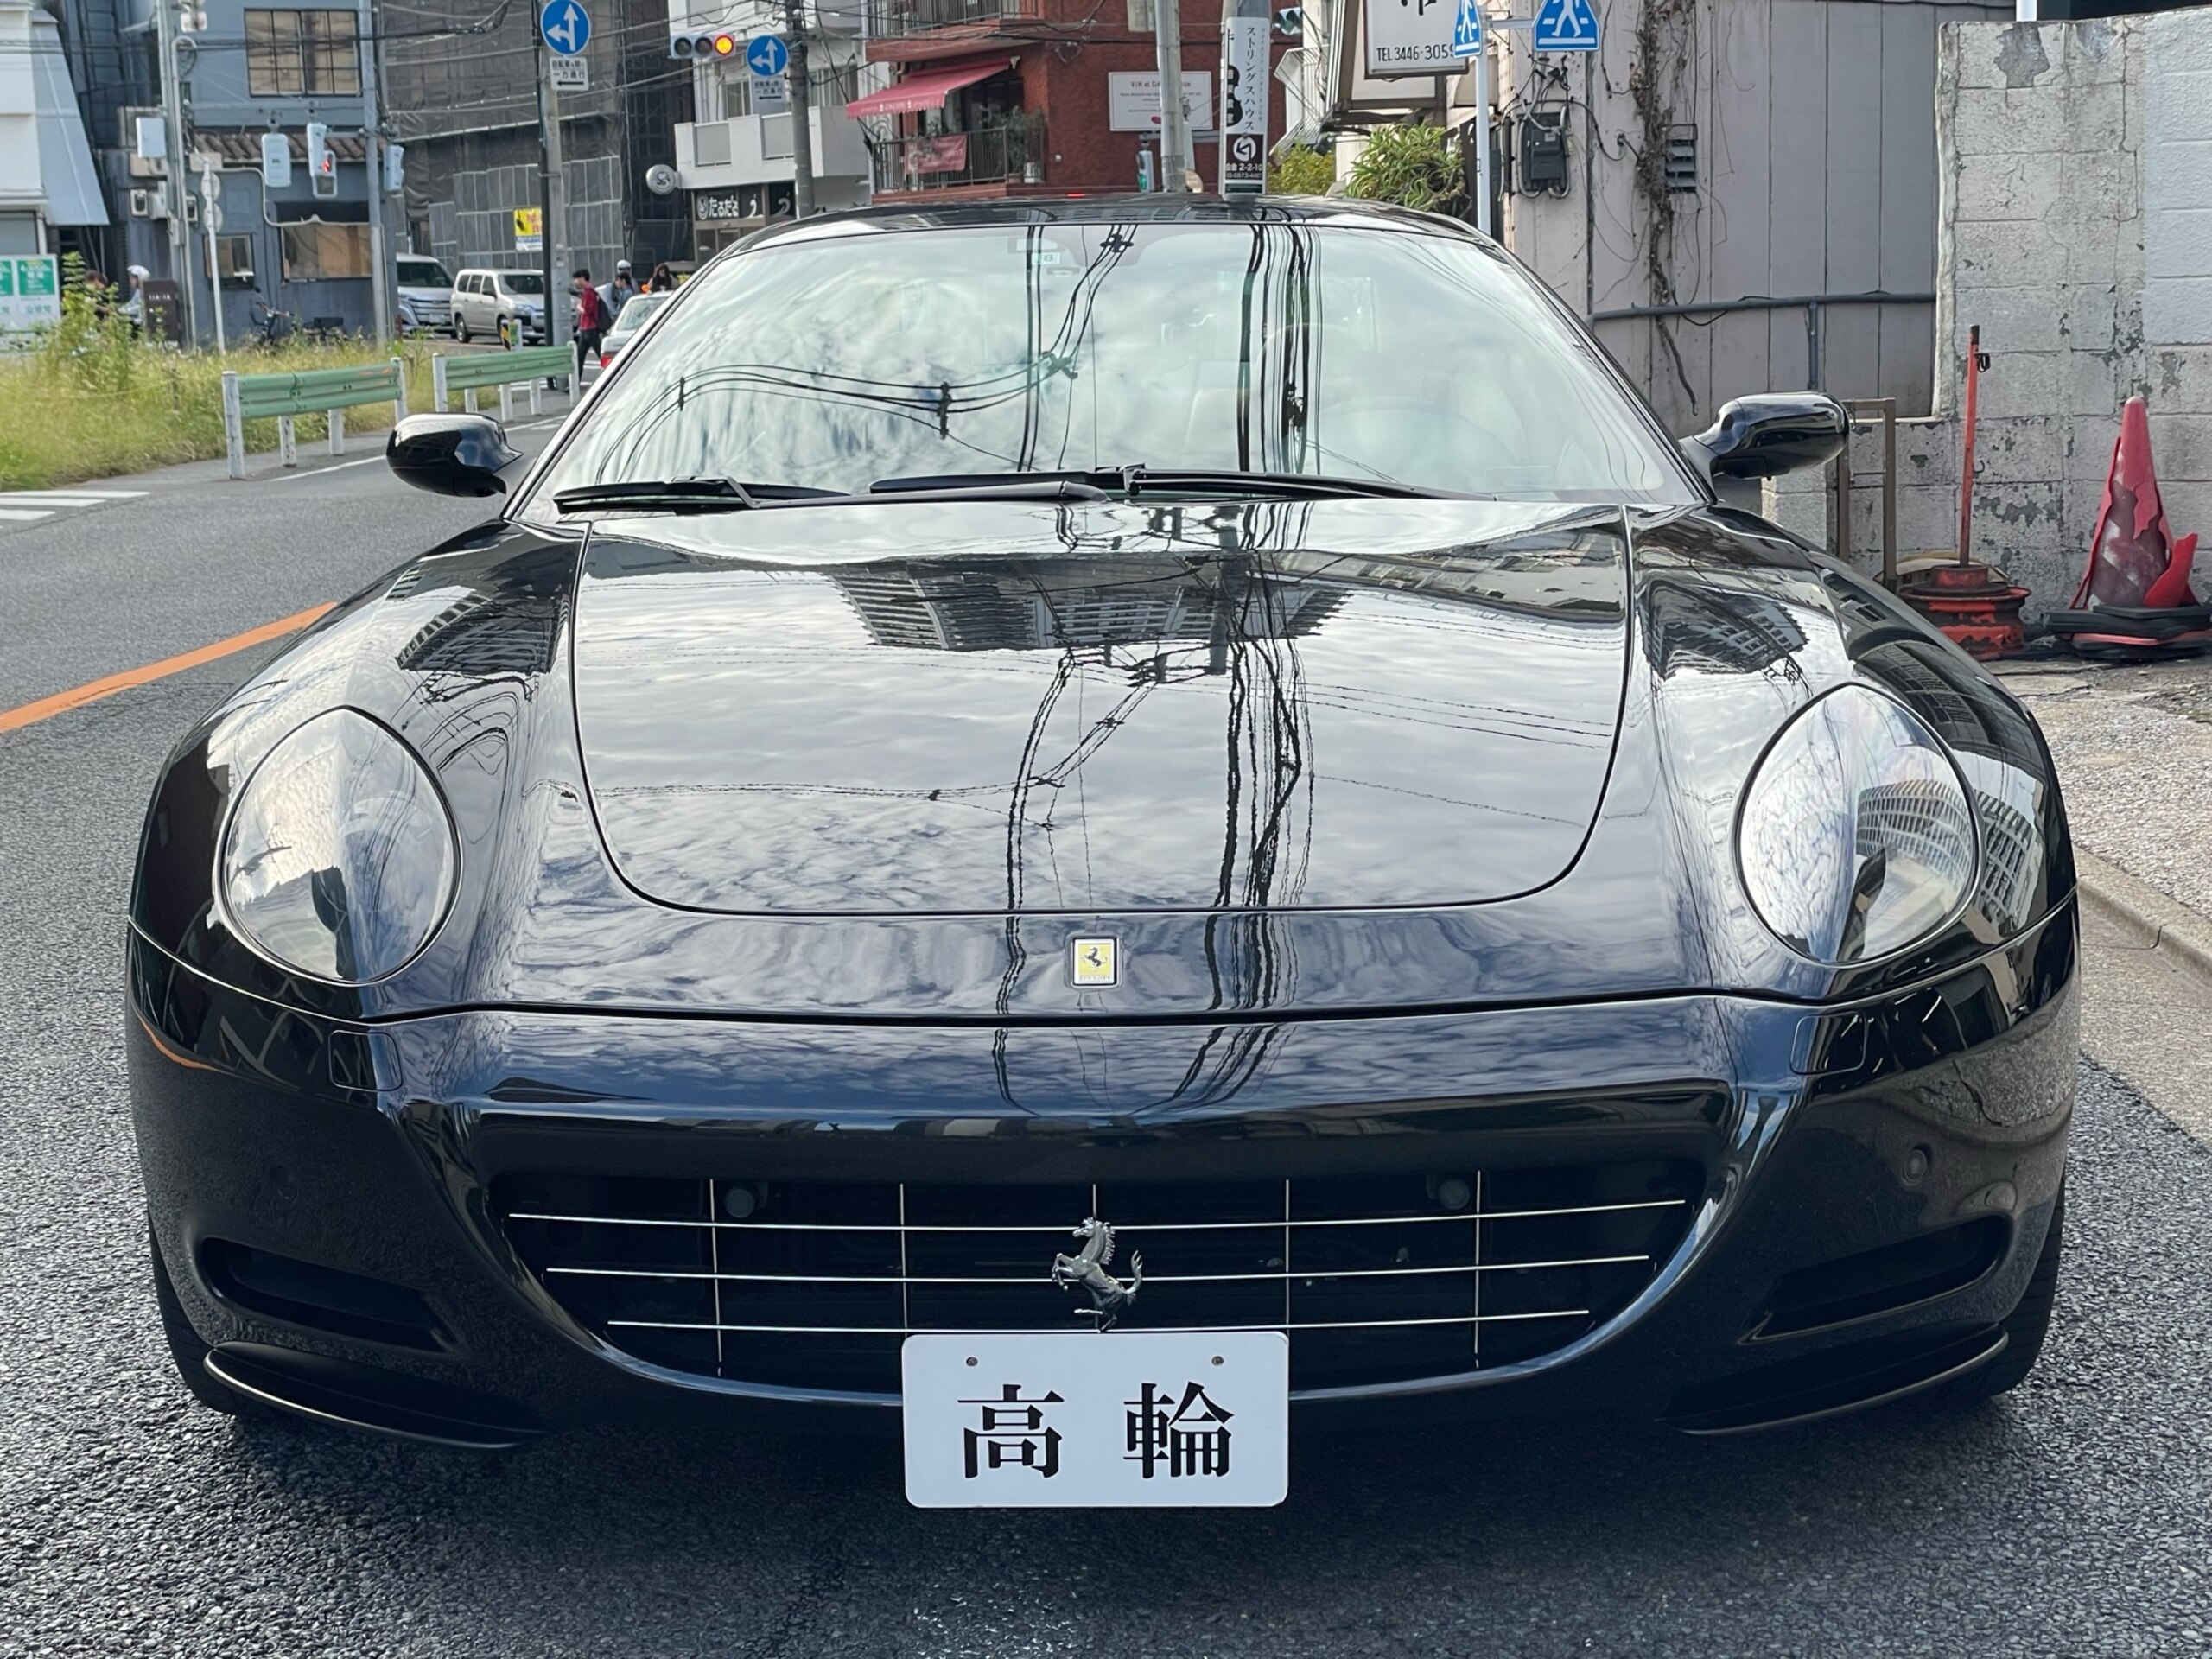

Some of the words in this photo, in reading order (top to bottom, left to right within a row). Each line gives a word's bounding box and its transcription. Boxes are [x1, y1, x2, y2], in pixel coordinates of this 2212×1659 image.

[1244, 27, 1256, 130] ストリングスハウス
[1376, 47, 1392, 61] TEL
[957, 1381, 1235, 1478] 高輪
